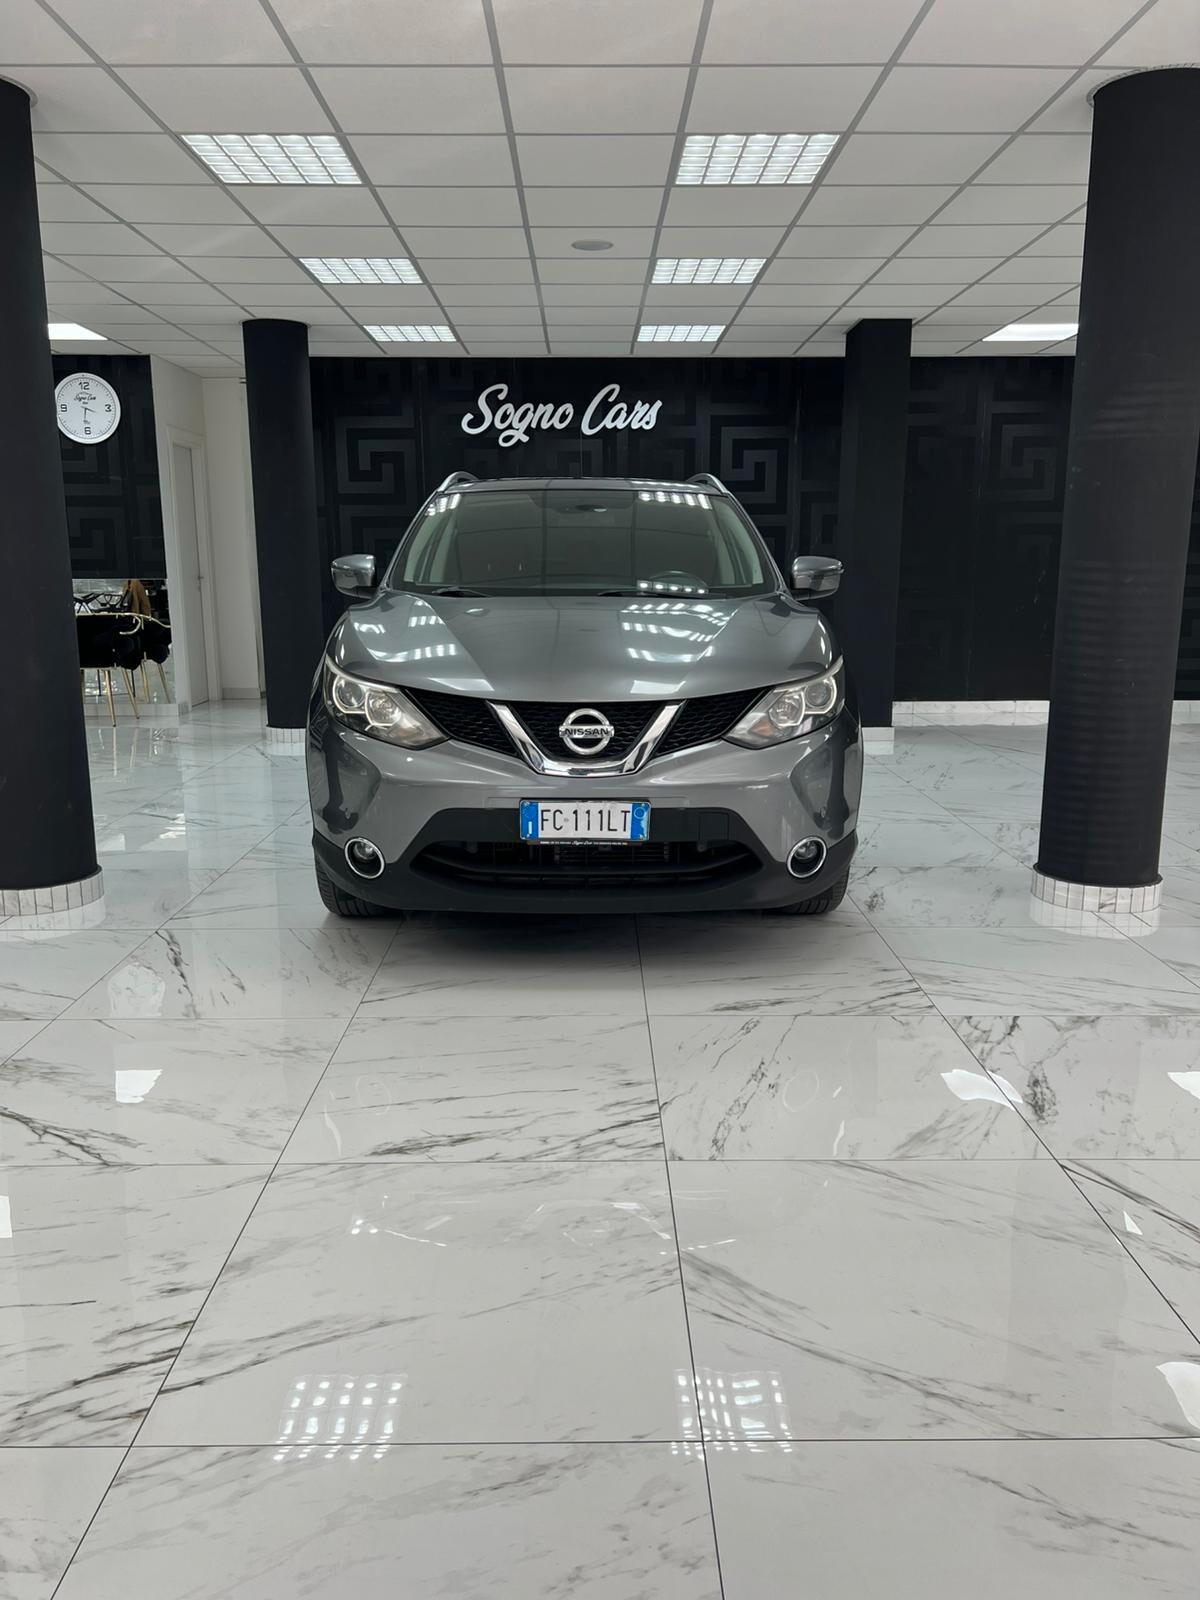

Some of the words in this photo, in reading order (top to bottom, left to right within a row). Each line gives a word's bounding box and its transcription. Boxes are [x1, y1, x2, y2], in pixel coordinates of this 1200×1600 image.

[78, 382, 90, 390] 12
[60, 404, 67, 412] 9
[105, 404, 112, 412] 3
[461, 383, 575, 448] Sogno
[581, 383, 663, 436] Cars
[84, 427, 91, 435] 6
[564, 727, 609, 736] NISSAN
[540, 809, 563, 831] FC
[572, 809, 631, 832] 111LT
